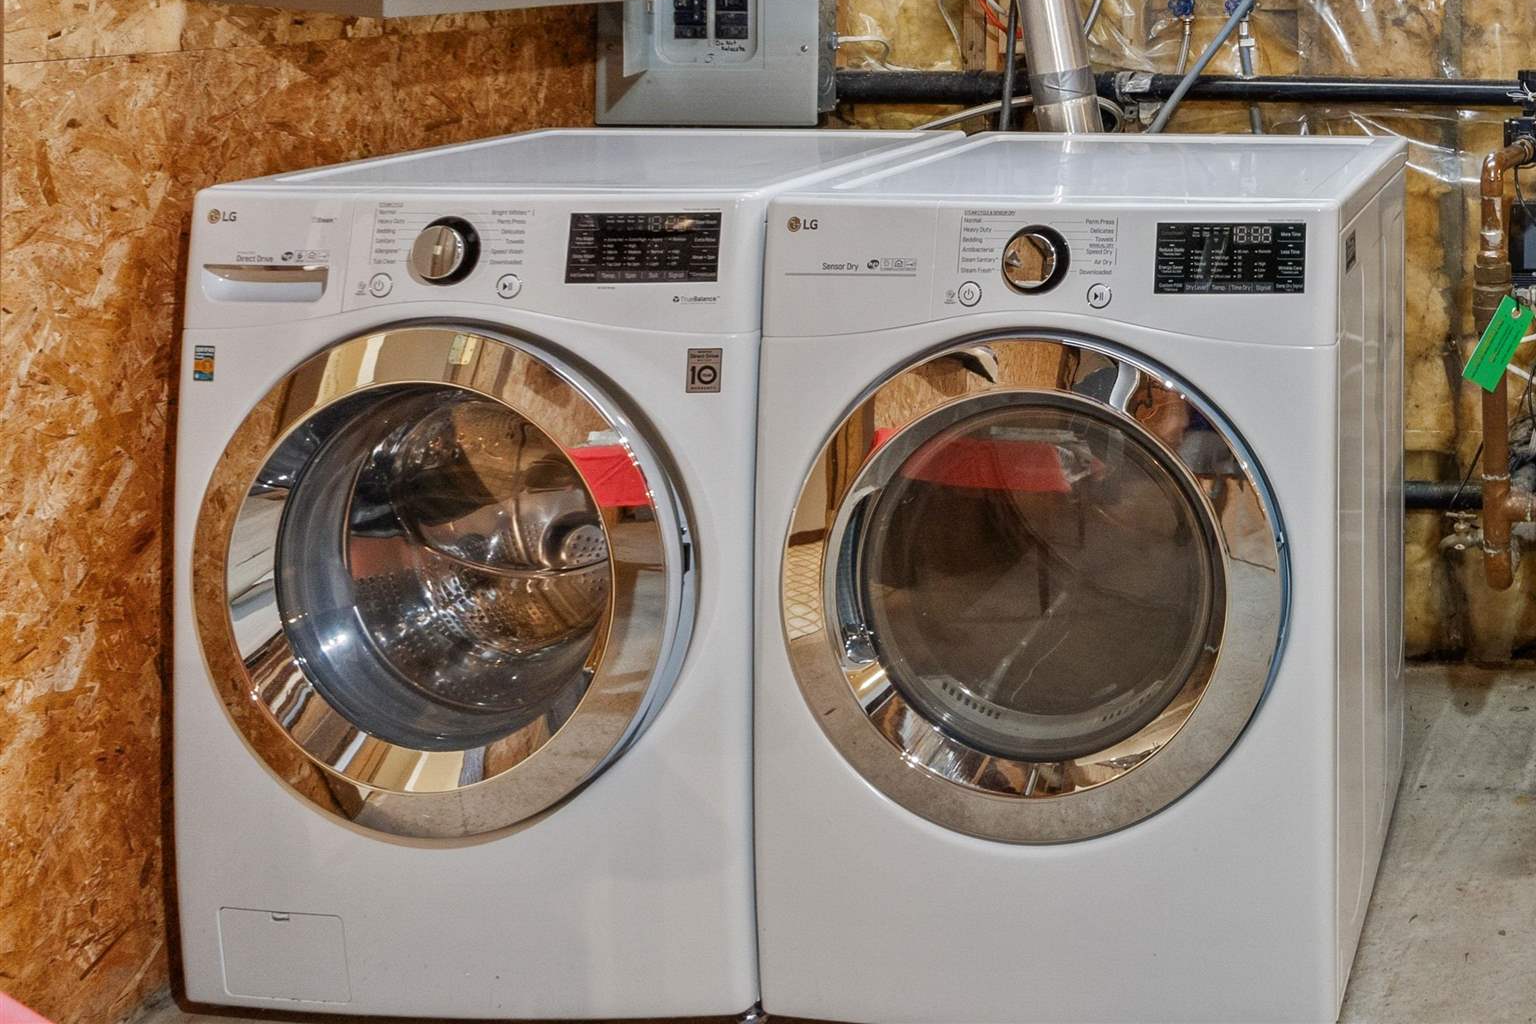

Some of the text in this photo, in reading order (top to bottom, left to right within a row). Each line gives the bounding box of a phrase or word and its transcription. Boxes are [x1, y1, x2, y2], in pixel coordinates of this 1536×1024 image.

[822, 262, 859, 272] Sensor Dry
[690, 365, 717, 385] 10
